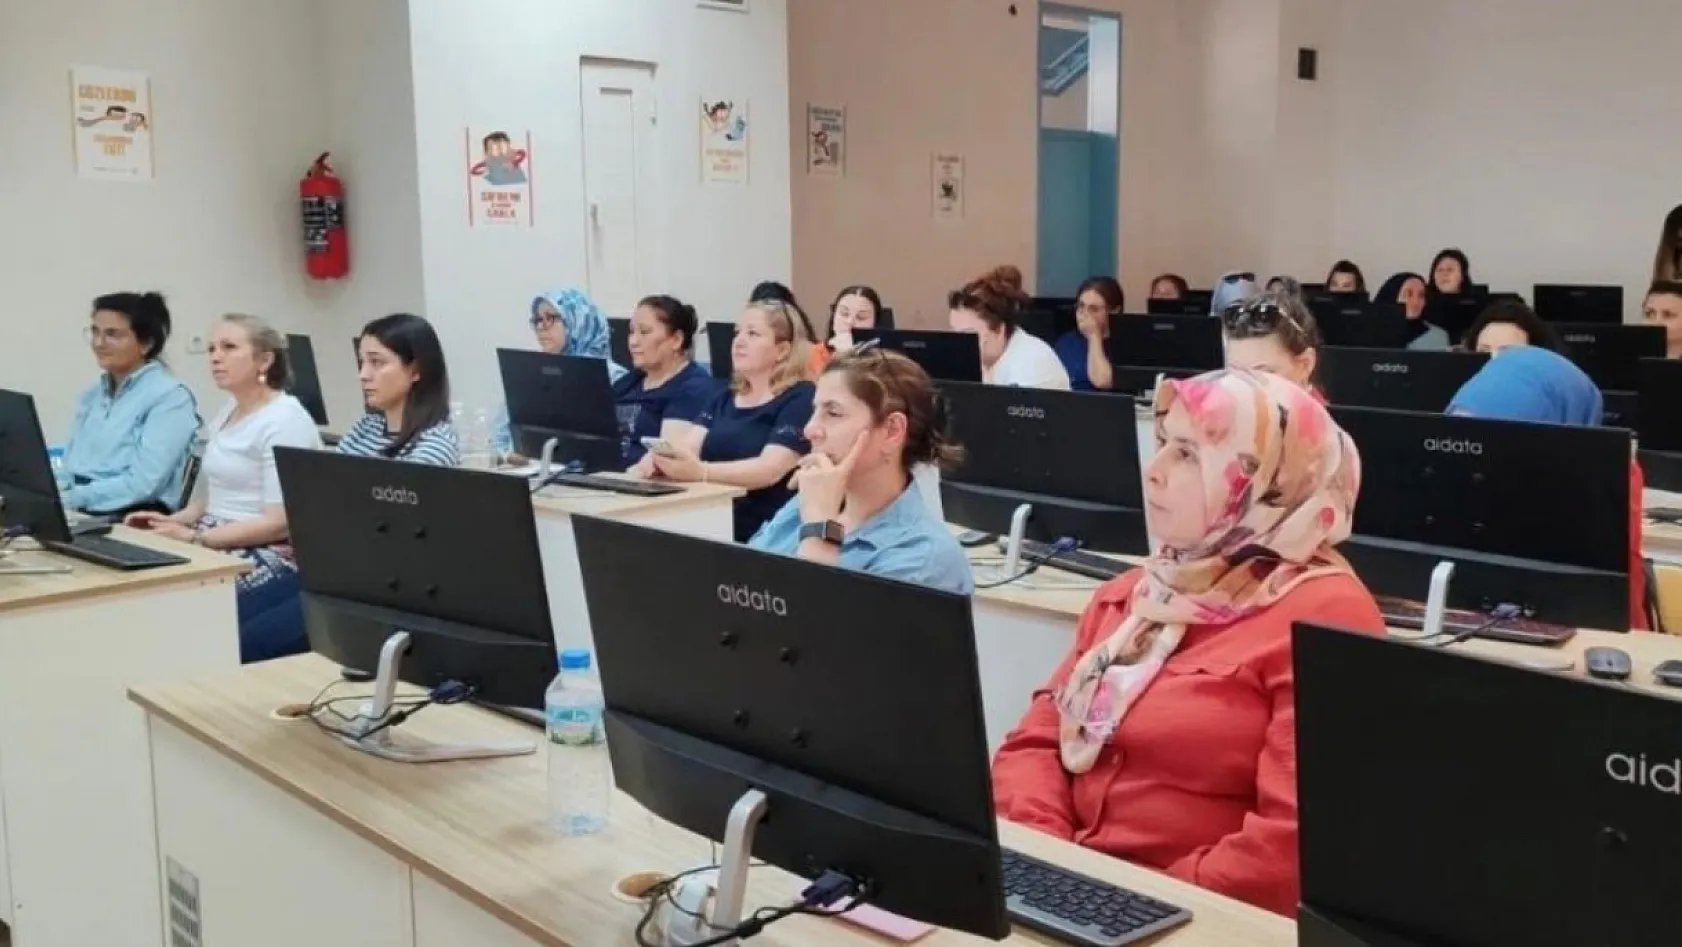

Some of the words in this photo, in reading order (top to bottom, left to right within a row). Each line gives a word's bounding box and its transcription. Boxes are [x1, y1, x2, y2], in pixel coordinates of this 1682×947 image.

[1423, 437, 1483, 455] aidata
[371, 484, 419, 505] aidata
[716, 582, 787, 616] aidata
